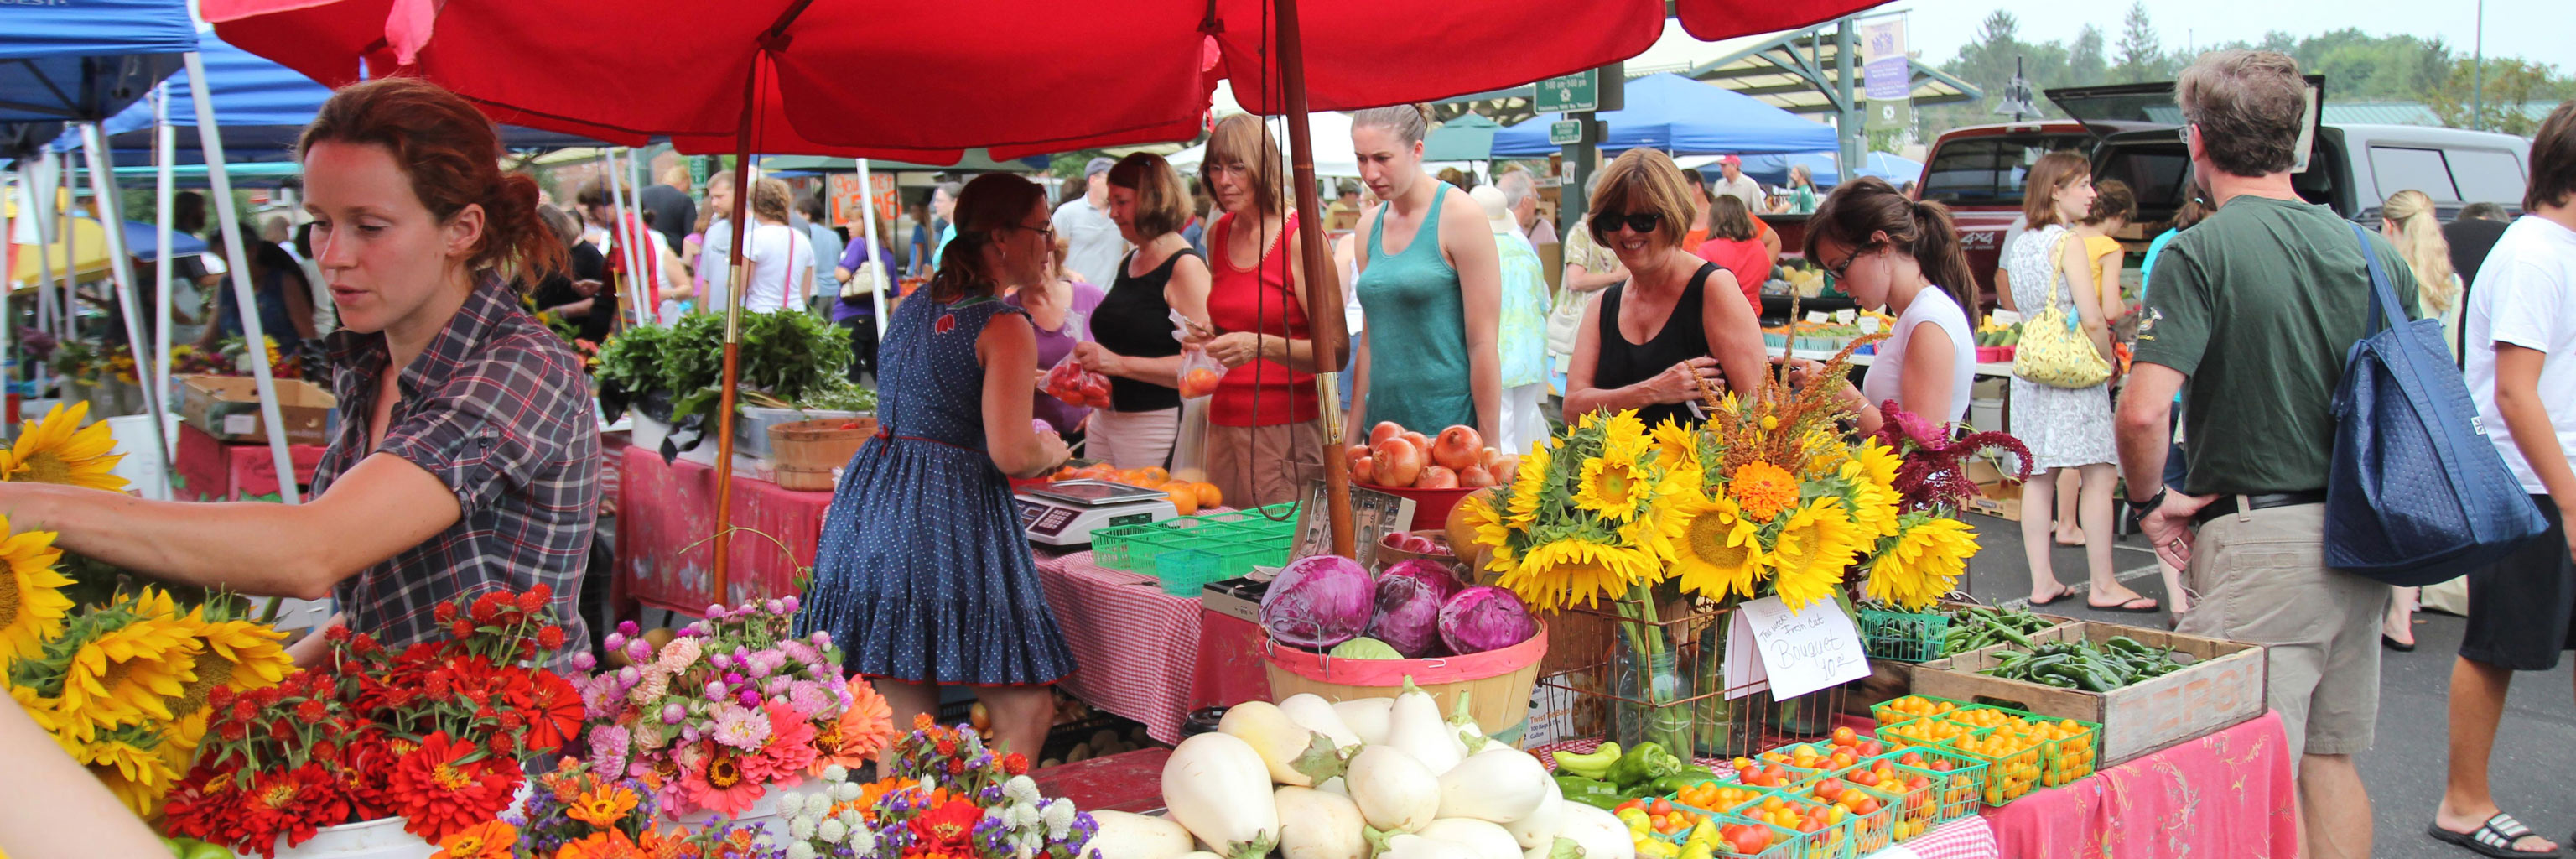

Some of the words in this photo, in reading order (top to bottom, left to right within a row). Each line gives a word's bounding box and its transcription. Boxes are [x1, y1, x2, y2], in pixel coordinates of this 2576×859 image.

[1782, 623, 1805, 636] Fresh
[1808, 613, 1825, 628] Cut
[1770, 629, 1845, 669] Bouquet
[2117, 664, 2255, 745] PEPSI
[1530, 714, 1546, 724] Twist
[1530, 724, 1539, 732] 100
[1539, 722, 1549, 731] Bags
[1530, 731, 1545, 740] Gallon
